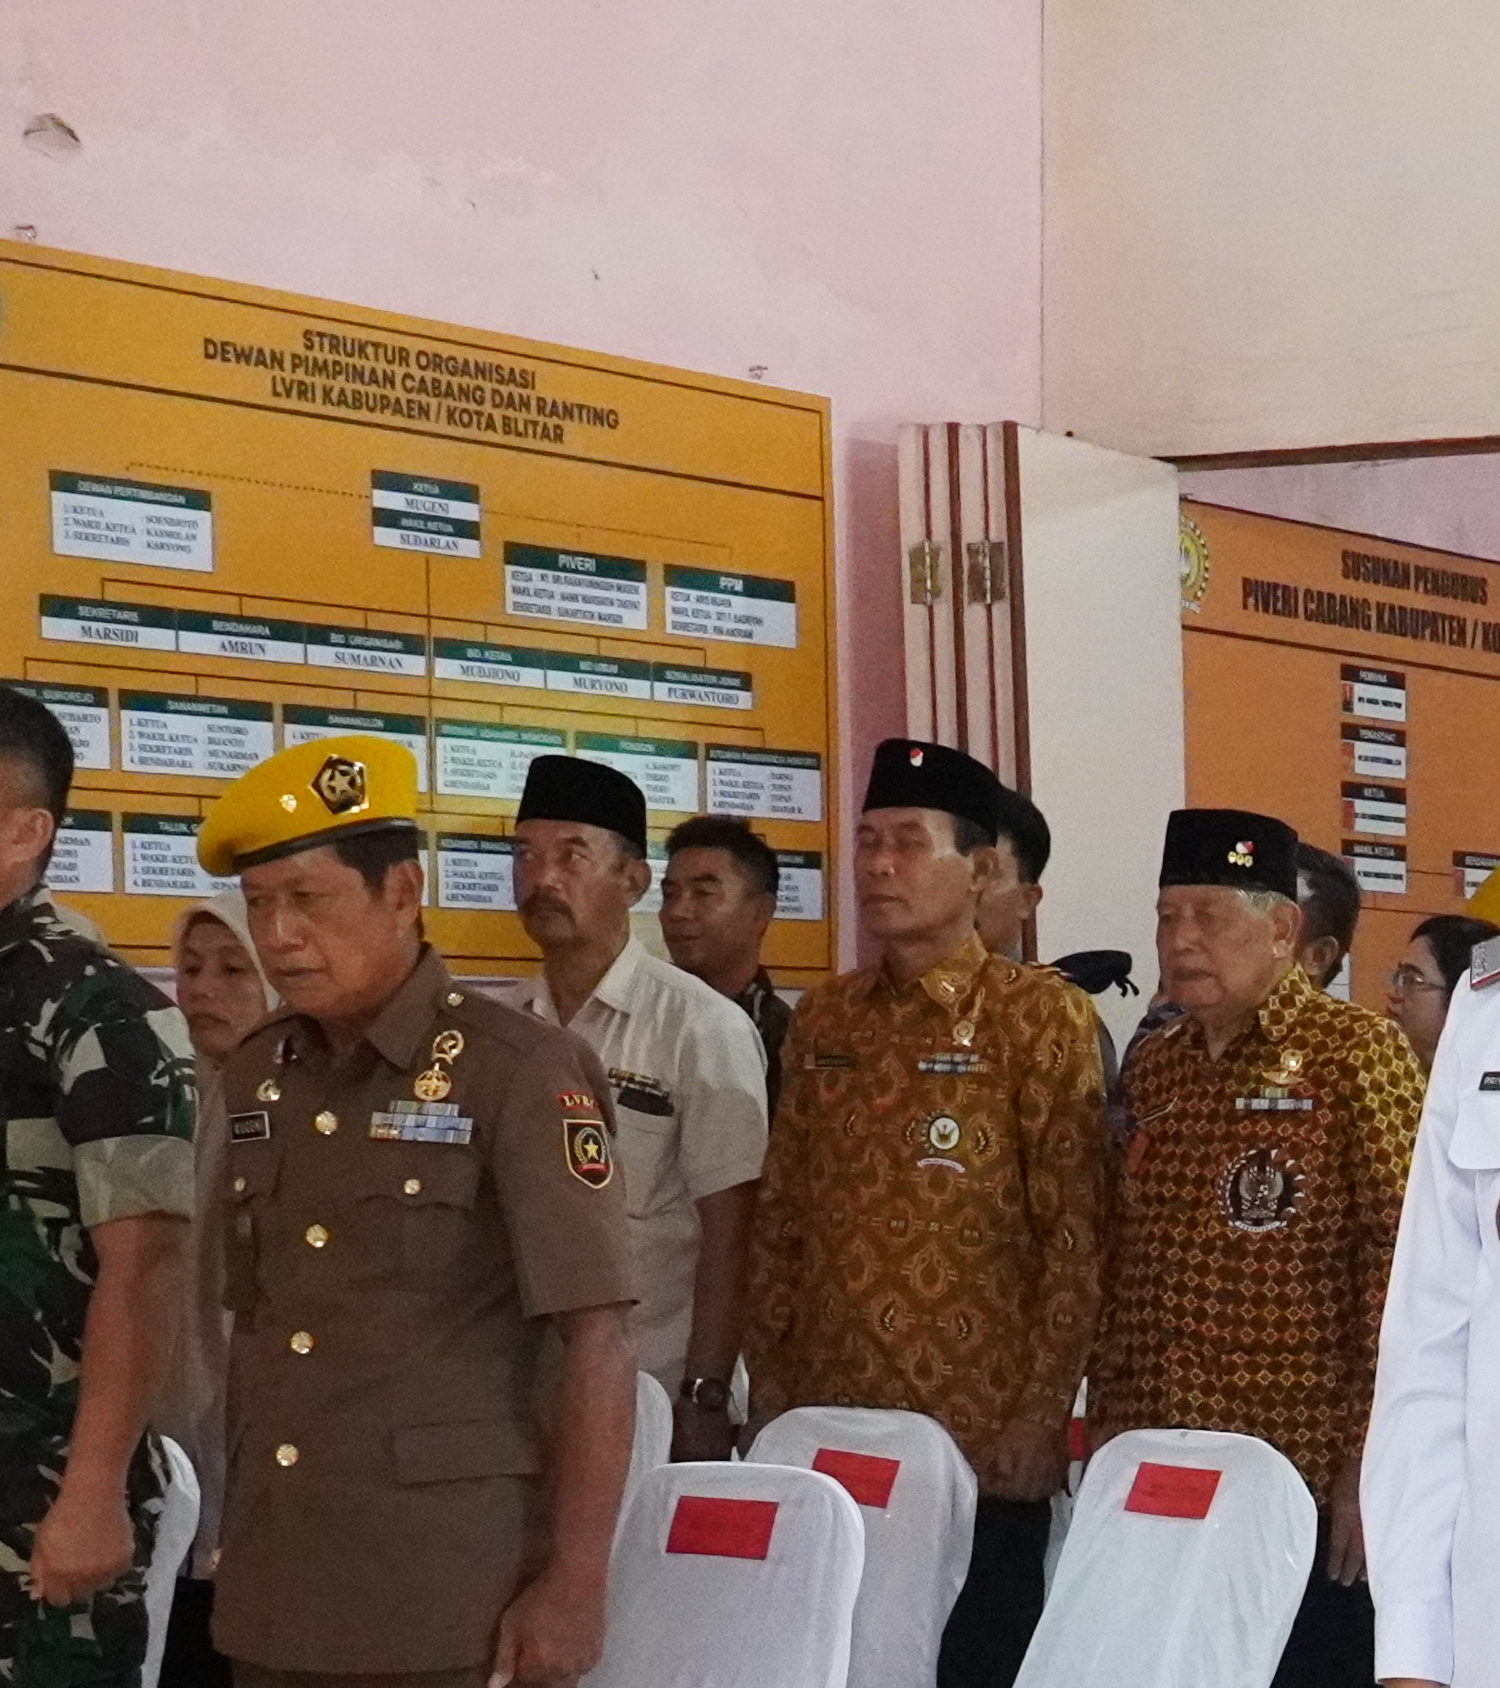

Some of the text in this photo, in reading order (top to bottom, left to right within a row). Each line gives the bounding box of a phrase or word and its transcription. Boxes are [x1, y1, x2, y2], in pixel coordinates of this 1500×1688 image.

[203, 338, 619, 429] DEWAN PIMPINAN CABANG DAN RANTING
[303, 329, 536, 390] STRUKTUR ORGANISASI
[271, 375, 316, 401] LVRI
[322, 385, 431, 420] KABUPAEN
[447, 407, 498, 432] KOTA
[502, 415, 563, 444] BLITAR
[405, 498, 449, 514] MUGENI
[400, 534, 459, 550] SUDARLAN
[1341, 549, 1410, 591] SUSUNAN
[81, 625, 139, 643] MARSIDI
[1242, 577, 1298, 619] PIVERI
[1304, 589, 1371, 631] CABANG
[1376, 601, 1466, 647] KABUPATEN
